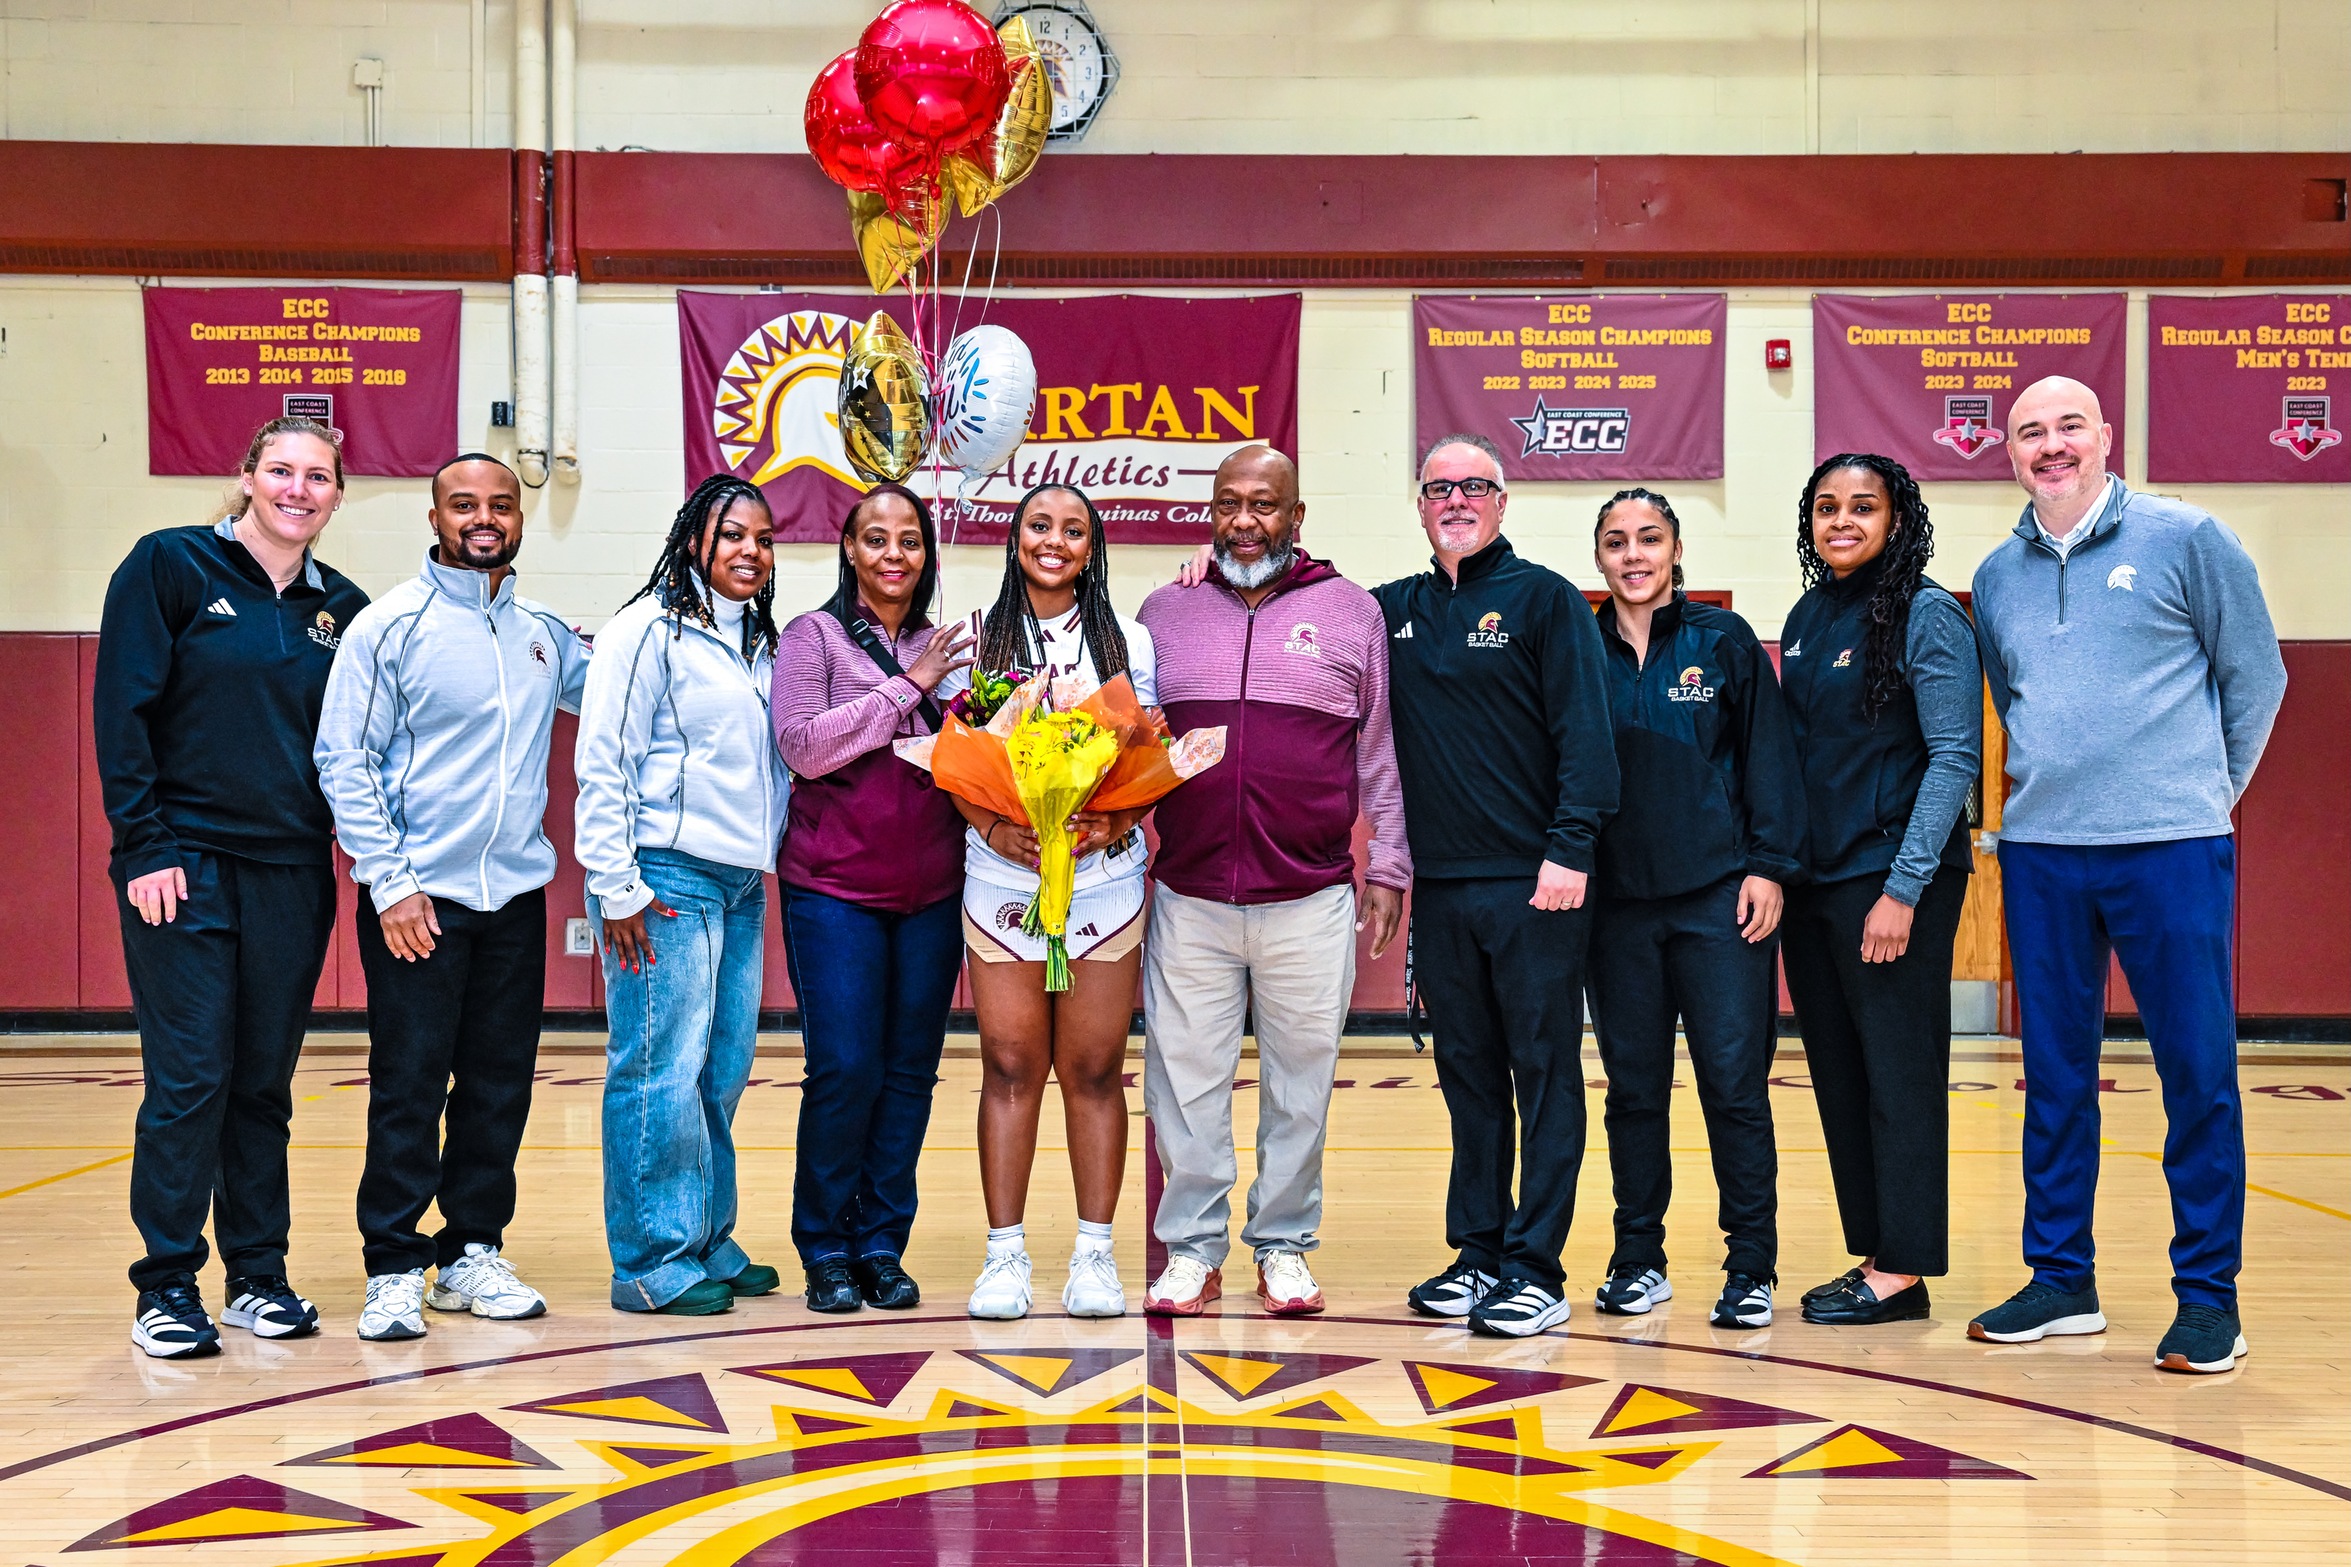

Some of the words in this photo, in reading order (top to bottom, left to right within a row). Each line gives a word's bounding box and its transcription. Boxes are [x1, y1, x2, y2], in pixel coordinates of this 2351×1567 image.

[1039, 21, 1051, 34] 12
[1079, 44, 1087, 56] 2
[1085, 66, 1092, 80] 3
[1078, 89, 1085, 104] 4
[1061, 105, 1068, 118] 5
[282, 298, 329, 319] ECC
[1548, 304, 1592, 324] ECC
[1947, 303, 1992, 323] ECC
[2286, 303, 2331, 323] ECC
[190, 322, 309, 341] CONFERENCE
[312, 322, 421, 343] CHAMPIONS
[1428, 327, 1515, 347] REGULAR
[1519, 326, 1596, 346] SEASON
[1600, 326, 1713, 346] CHAMPIONS
[1847, 325, 1971, 345] CONFERENCE
[1975, 325, 2091, 345] CHAMPIONS
[2161, 326, 2251, 346] REGULAR
[2257, 325, 2335, 345] SEASON
[258, 344, 353, 363] BASEBALL
[1520, 348, 1619, 369] SOFTBALL
[1921, 348, 2019, 368] SOFTBALL
[2237, 348, 2300, 369] MEN'S
[205, 367, 250, 385] 2013
[259, 367, 303, 385] 2014
[311, 367, 354, 385] 2015
[362, 368, 407, 386] 2018
[1483, 375, 1521, 390] 2022
[1528, 375, 1567, 390] 2023
[1574, 375, 1612, 389] 2024
[1618, 374, 1657, 389] 2025
[1925, 375, 1965, 390] 2023
[1973, 375, 2012, 390] 2024
[2287, 376, 2327, 391] 2023
[1025, 382, 1260, 440] RTAN
[1541, 420, 1627, 450] ECC
[975, 450, 1171, 496] Athletics
[966, 504, 1014, 523] Tho
[1097, 504, 1160, 523] uinas
[1284, 641, 1321, 653] STAC
[1466, 632, 1510, 643] STAC
[1667, 686, 1714, 698] STAC
